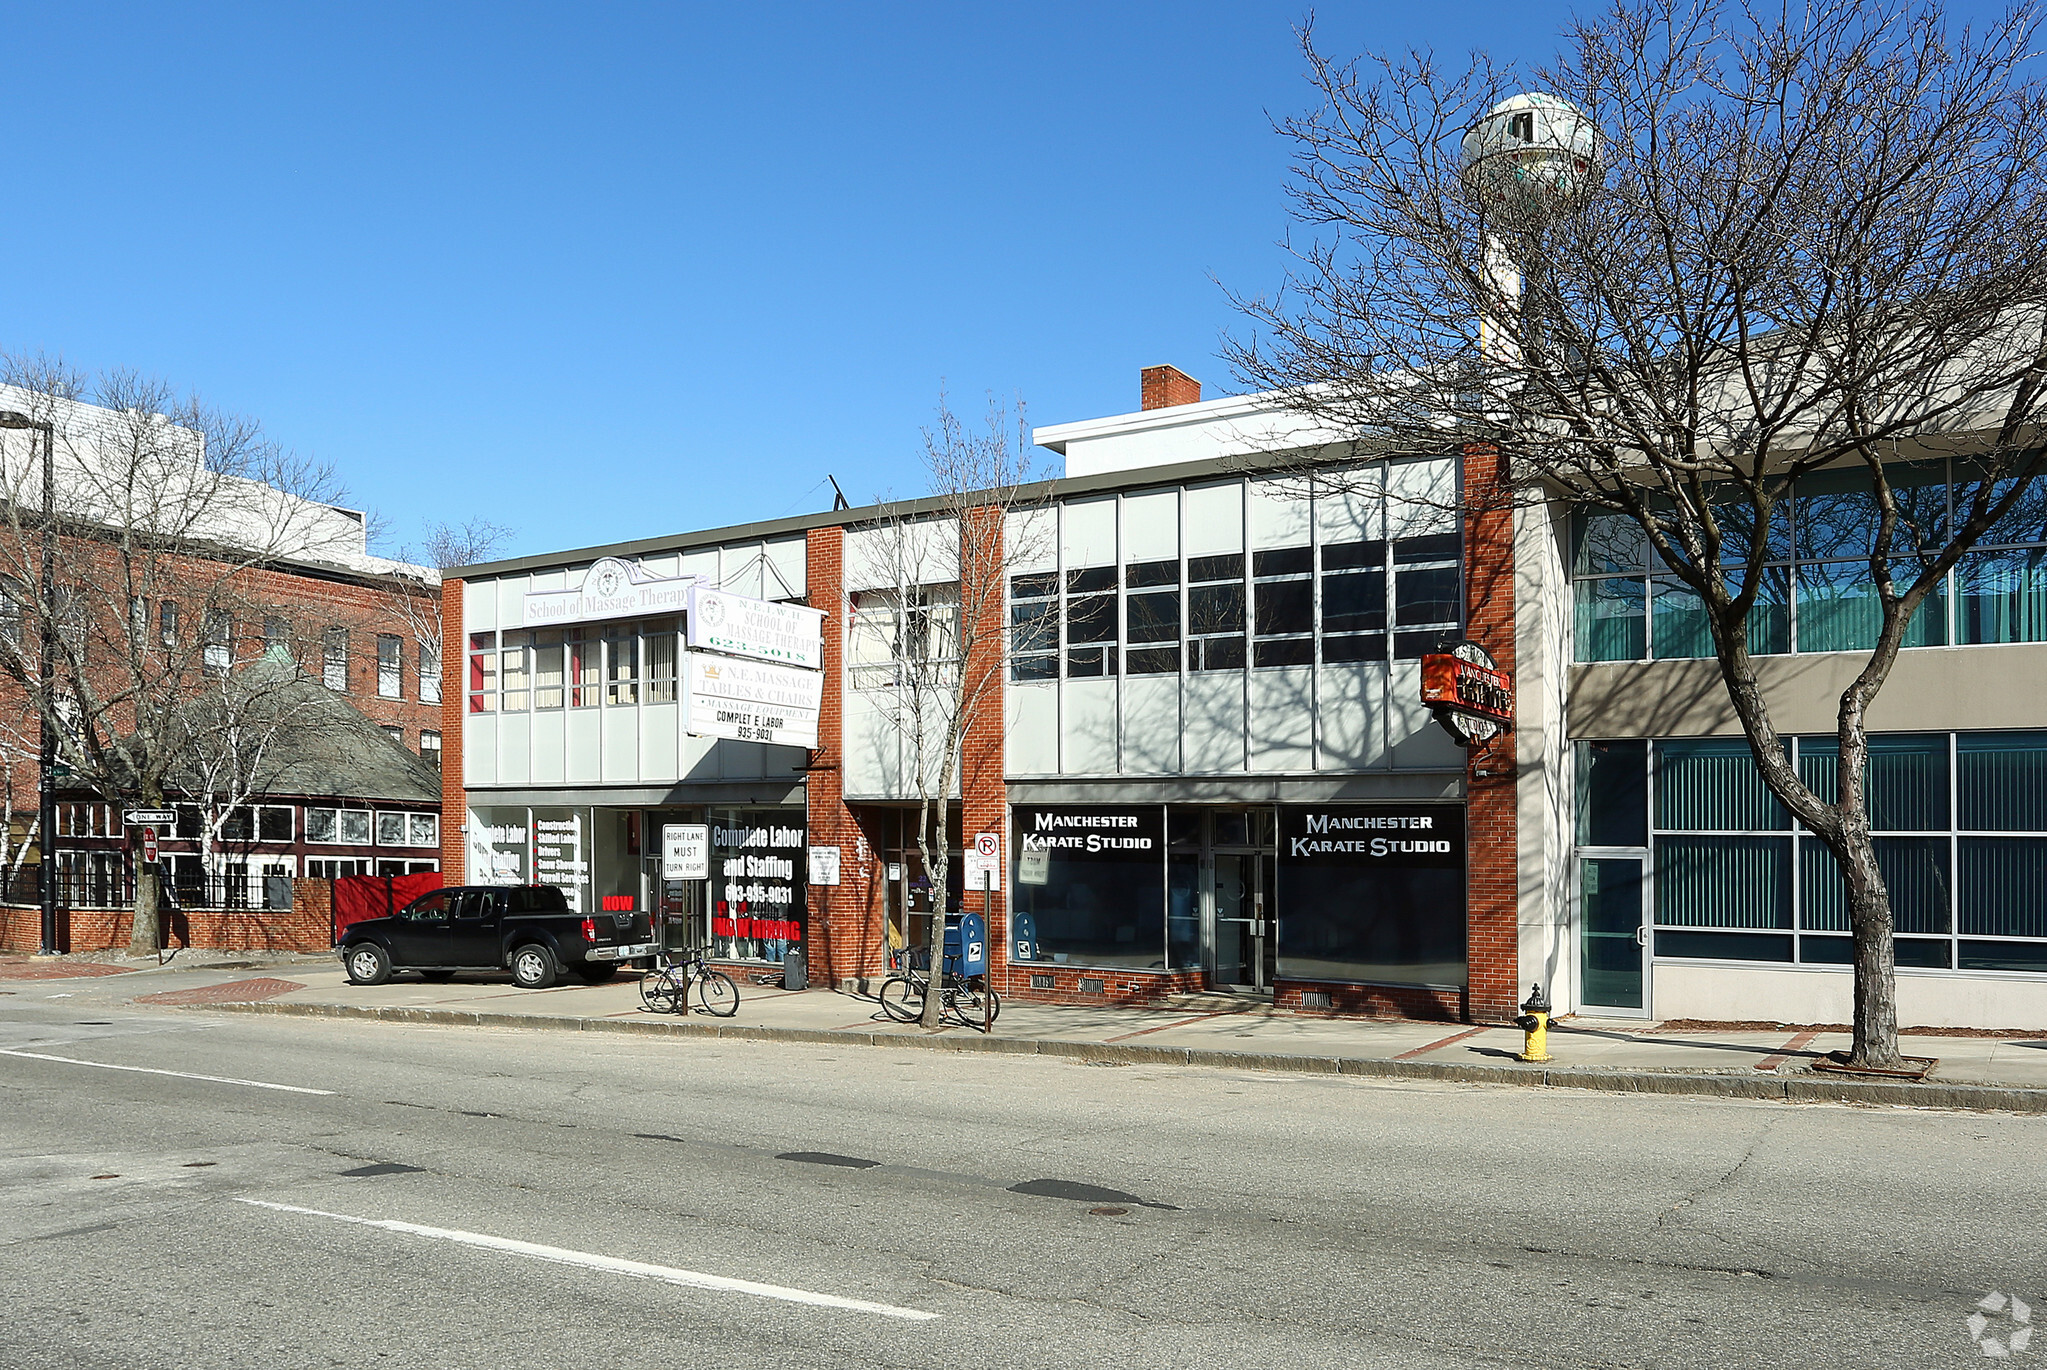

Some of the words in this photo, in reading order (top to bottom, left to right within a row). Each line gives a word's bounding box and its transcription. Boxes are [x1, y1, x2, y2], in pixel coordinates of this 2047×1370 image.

[529, 599, 566, 619] School
[570, 598, 582, 614] of
[585, 595, 636, 614] Massage
[745, 611, 782, 631] SCHOOL
[786, 619, 798, 634] OF
[727, 623, 771, 644] MASSAGE
[775, 632, 818, 653] THERAPY
[709, 636, 806, 661] 623-5018
[753, 671, 814, 690] MASSAGE
[700, 680, 752, 698] TABLES
[755, 687, 765, 700] &
[768, 690, 812, 706] CHAIRS
[707, 699, 753, 713] MASSAGE
[756, 705, 810, 719] EQUIPMENT
[717, 710, 751, 725] COMPLET
[754, 716, 760, 727] E
[762, 717, 784, 729] LABOR
[738, 726, 773, 742] 935-9031
[538, 820, 577, 831] Constructio
[1035, 813, 1138, 831] MANCHESTER
[1306, 814, 1433, 834] MANCHESTER
[506, 823, 526, 844] Labor
[537, 832, 560, 844] Skilled
[560, 833, 576, 844] Labo
[666, 832, 685, 841] RIGHT
[686, 832, 704, 841] LANE
[713, 825, 768, 849] Complete
[769, 825, 804, 848] Labor
[1022, 833, 1083, 851] KARATE
[1086, 834, 1152, 852] STUDIO
[538, 846, 561, 857] Drivers
[673, 846, 697, 857] MUST
[1291, 837, 1365, 857] KARATE
[1370, 837, 1451, 857] STUDIO
[538, 859, 555, 870] Snow
[556, 859, 588, 872] Shoveng
[666, 863, 683, 872] TURN
[685, 862, 704, 872] RIGHT
[723, 855, 745, 877] and
[746, 855, 793, 880] Staffing
[538, 872, 560, 883] Payroll
[602, 896, 634, 911] NOW
[725, 885, 792, 904] 603-935-9031
[717, 918, 751, 938] NOW
[752, 919, 801, 941] HIRING
